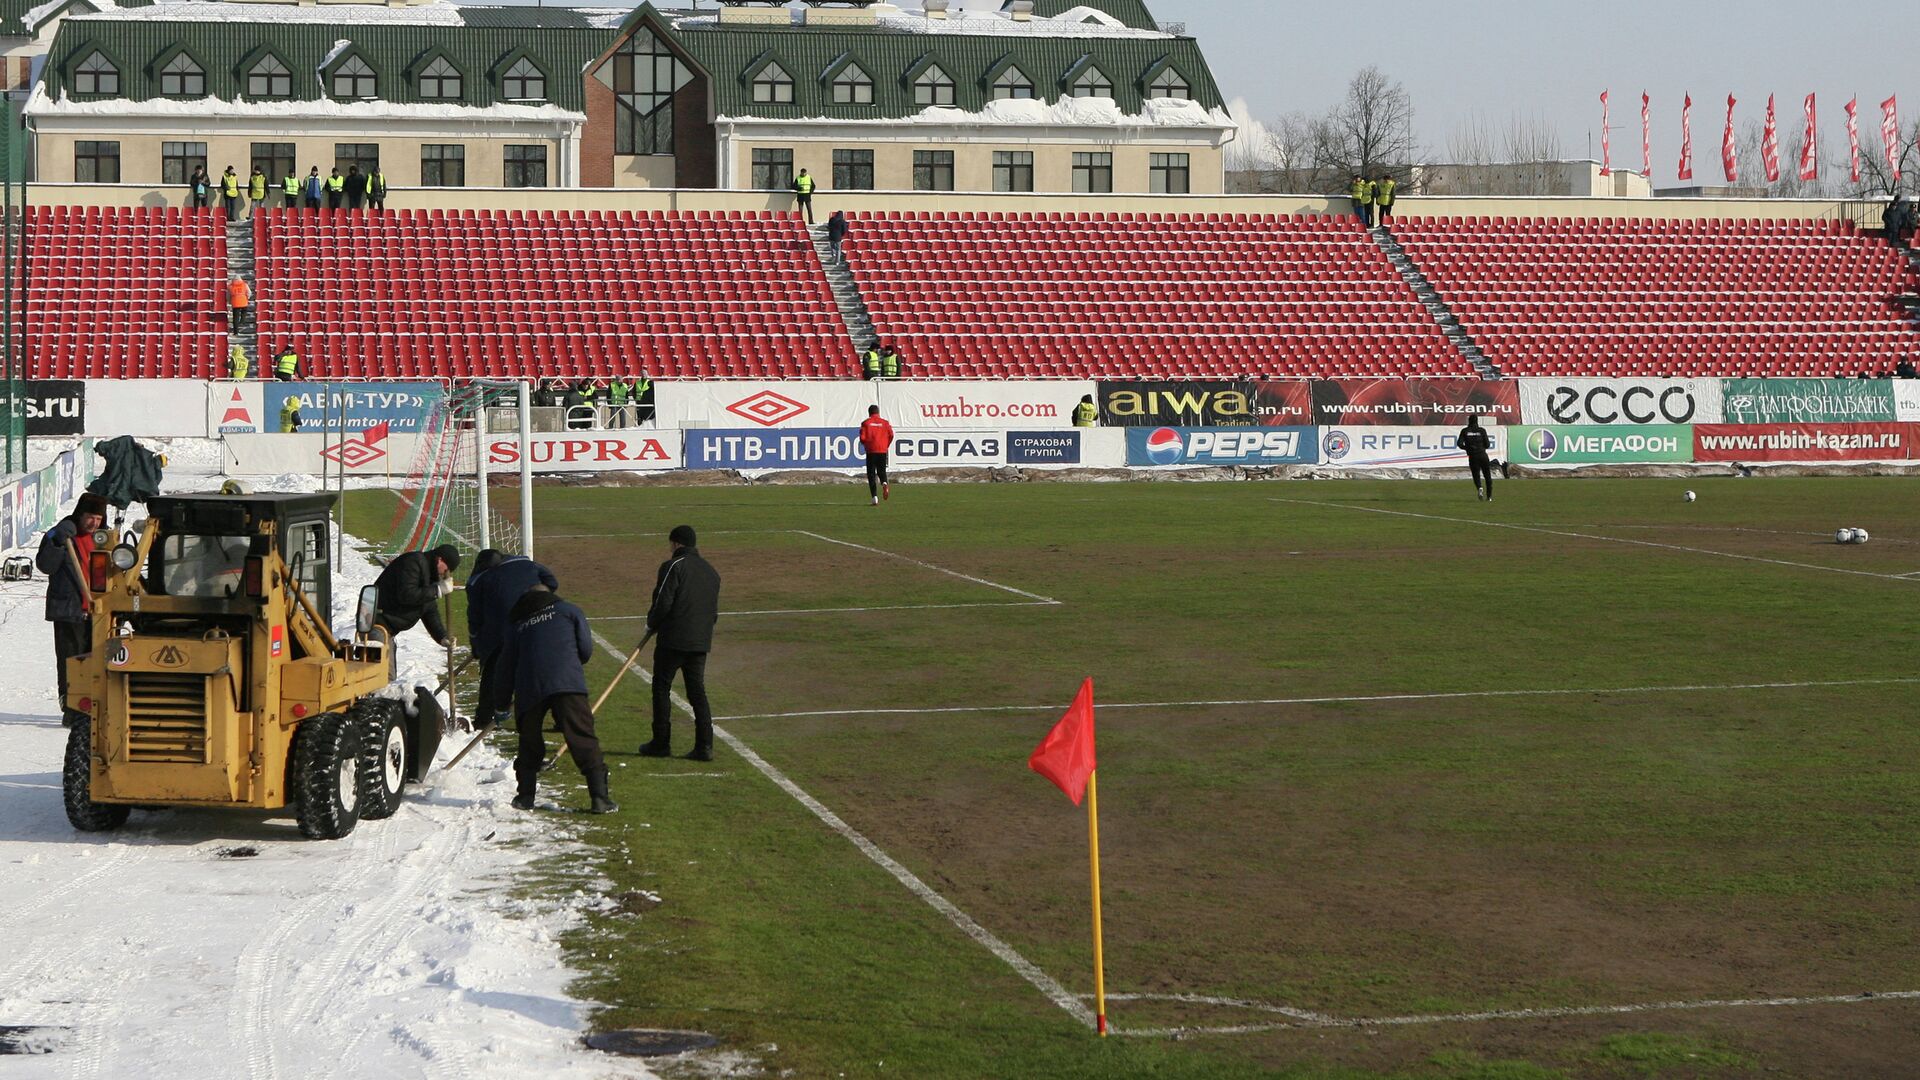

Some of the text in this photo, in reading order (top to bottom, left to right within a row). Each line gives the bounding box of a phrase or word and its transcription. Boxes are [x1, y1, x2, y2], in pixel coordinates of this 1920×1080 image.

[920, 396, 1057, 418] umbro.com
[1109, 391, 1249, 416] aiwa
[1547, 387, 1695, 424] ecco
[1758, 394, 1890, 417] ТАТФОНДБАНК
[488, 438, 671, 463] SUPRA
[895, 439, 999, 457] СОГАЗ
[1014, 438, 1072, 447] СТРАХОВАЯ
[1187, 431, 1300, 458] PEPSI
[1361, 435, 1495, 449] RFPL.OG
[1701, 430, 1900, 450] www.rubin-kazan.ru
[1024, 448, 1063, 457] ГРУППА
